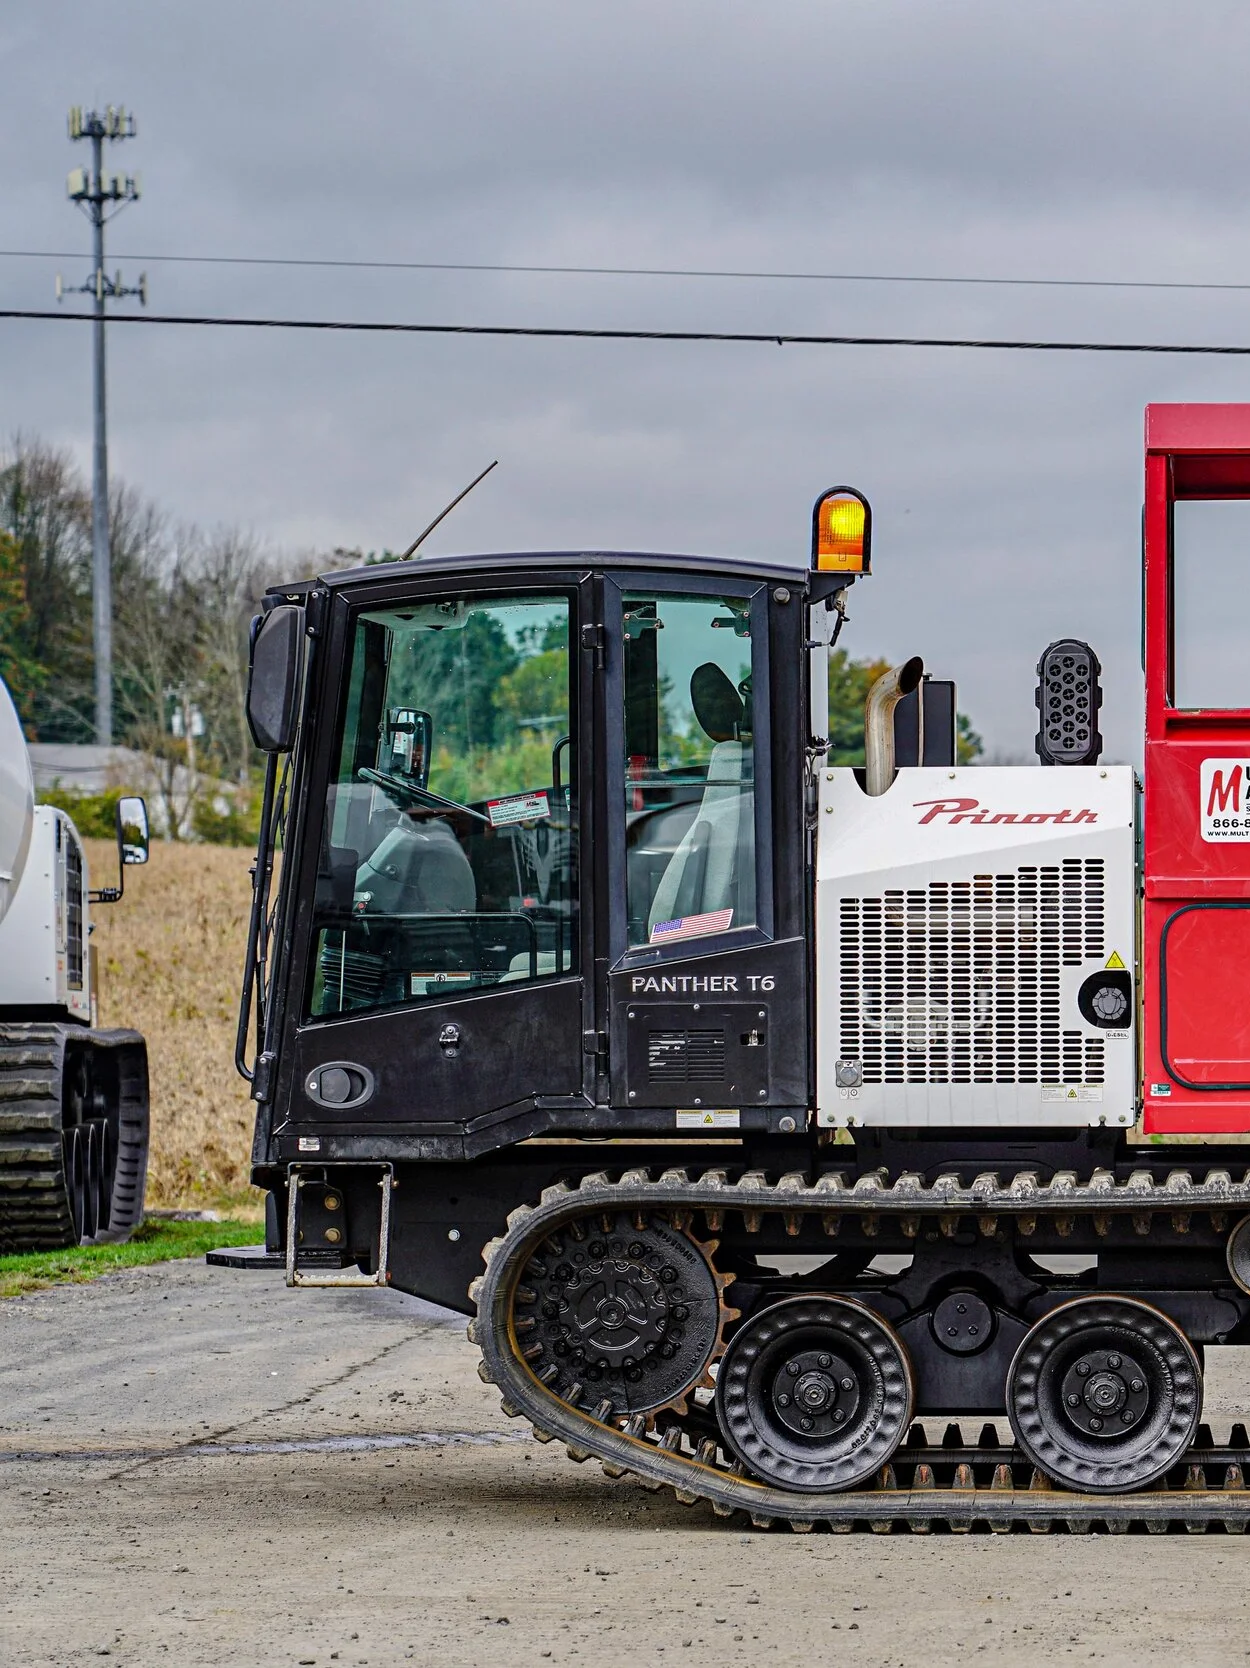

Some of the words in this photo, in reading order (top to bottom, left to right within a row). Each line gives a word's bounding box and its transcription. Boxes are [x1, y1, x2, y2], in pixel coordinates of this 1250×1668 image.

[912, 798, 1098, 824] Prinoth
[631, 976, 739, 992] PANTHER
[746, 975, 776, 991] T6
